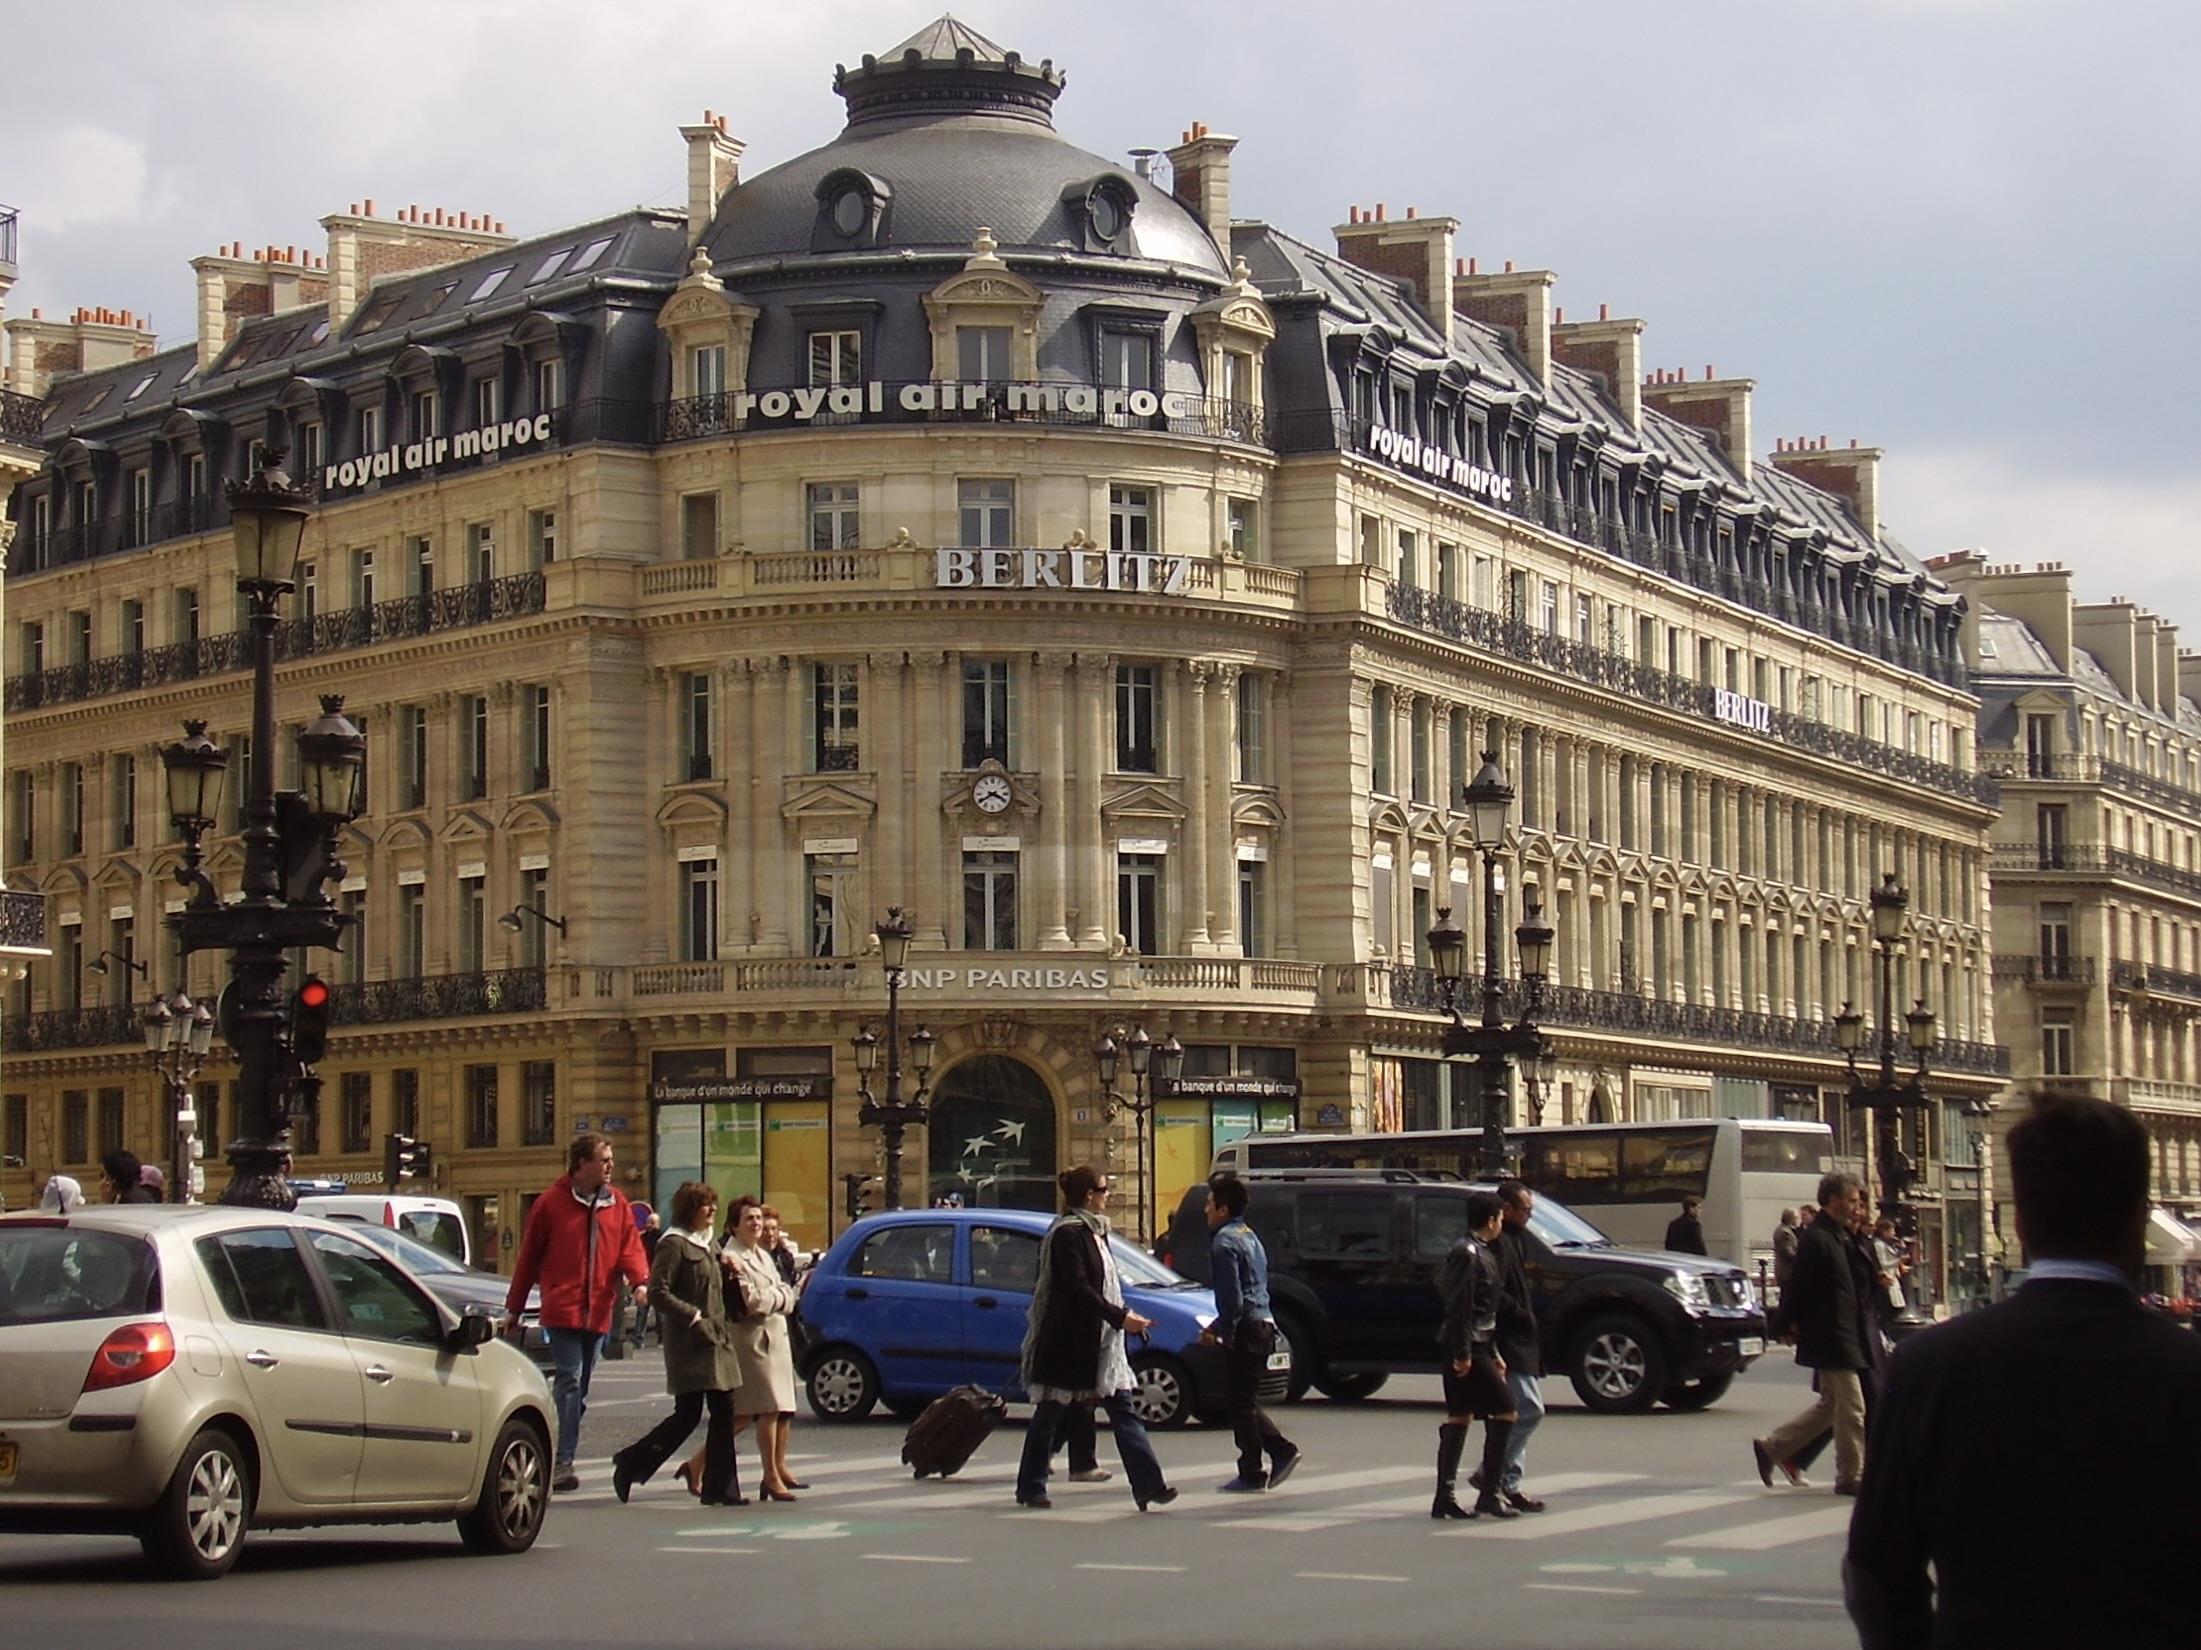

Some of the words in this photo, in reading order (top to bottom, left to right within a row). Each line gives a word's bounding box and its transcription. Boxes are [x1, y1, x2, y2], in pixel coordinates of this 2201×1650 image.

[737, 381, 883, 419] royal
[900, 381, 987, 411] air
[1007, 384, 1187, 418] maroc
[326, 444, 399, 489] royal
[405, 436, 448, 470] air
[454, 414, 551, 459] maroc
[1370, 425, 1420, 467] royal
[1422, 446, 1450, 479] air
[1452, 458, 1512, 502] maroc
[936, 549, 1195, 594] BERLITZ
[1715, 687, 1771, 733] BERLITZ
[886, 968, 957, 988] BNP
[967, 968, 1109, 989] PARIBAS
[655, 1086, 664, 1098] La
[665, 1085, 696, 1099] banque
[698, 1084, 717, 1097] d'un
[719, 1083, 752, 1096] monde
[754, 1083, 770, 1098] qui
[773, 1082, 811, 1098] change
[1181, 1079, 1214, 1095] banque
[1216, 1080, 1235, 1093] d'un
[1236, 1081, 1262, 1093] monde
[1263, 1082, 1275, 1096] qui
[342, 1171, 384, 1185] PARIBAS
